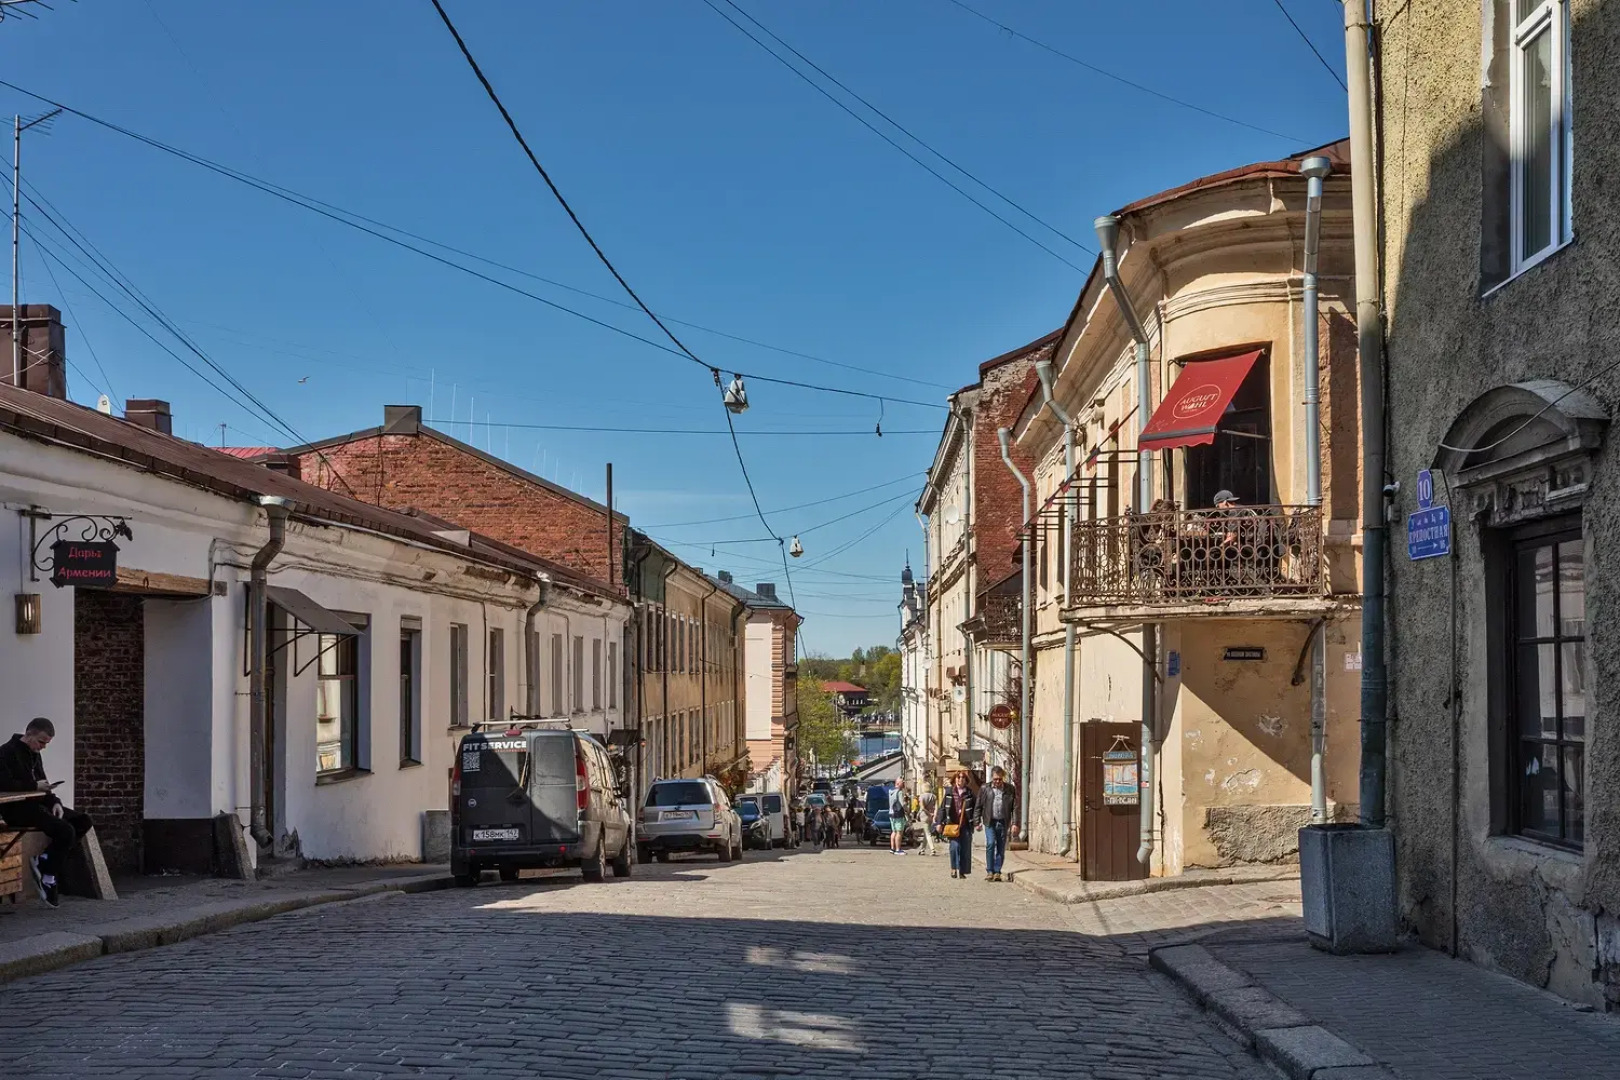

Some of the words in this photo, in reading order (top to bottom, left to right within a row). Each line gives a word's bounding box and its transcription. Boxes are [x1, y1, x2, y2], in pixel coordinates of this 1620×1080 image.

[1419, 479, 1430, 501] 10
[58, 566, 111, 579] Армении
[463, 743, 480, 751] FIT
[481, 741, 527, 750] SERVICE
